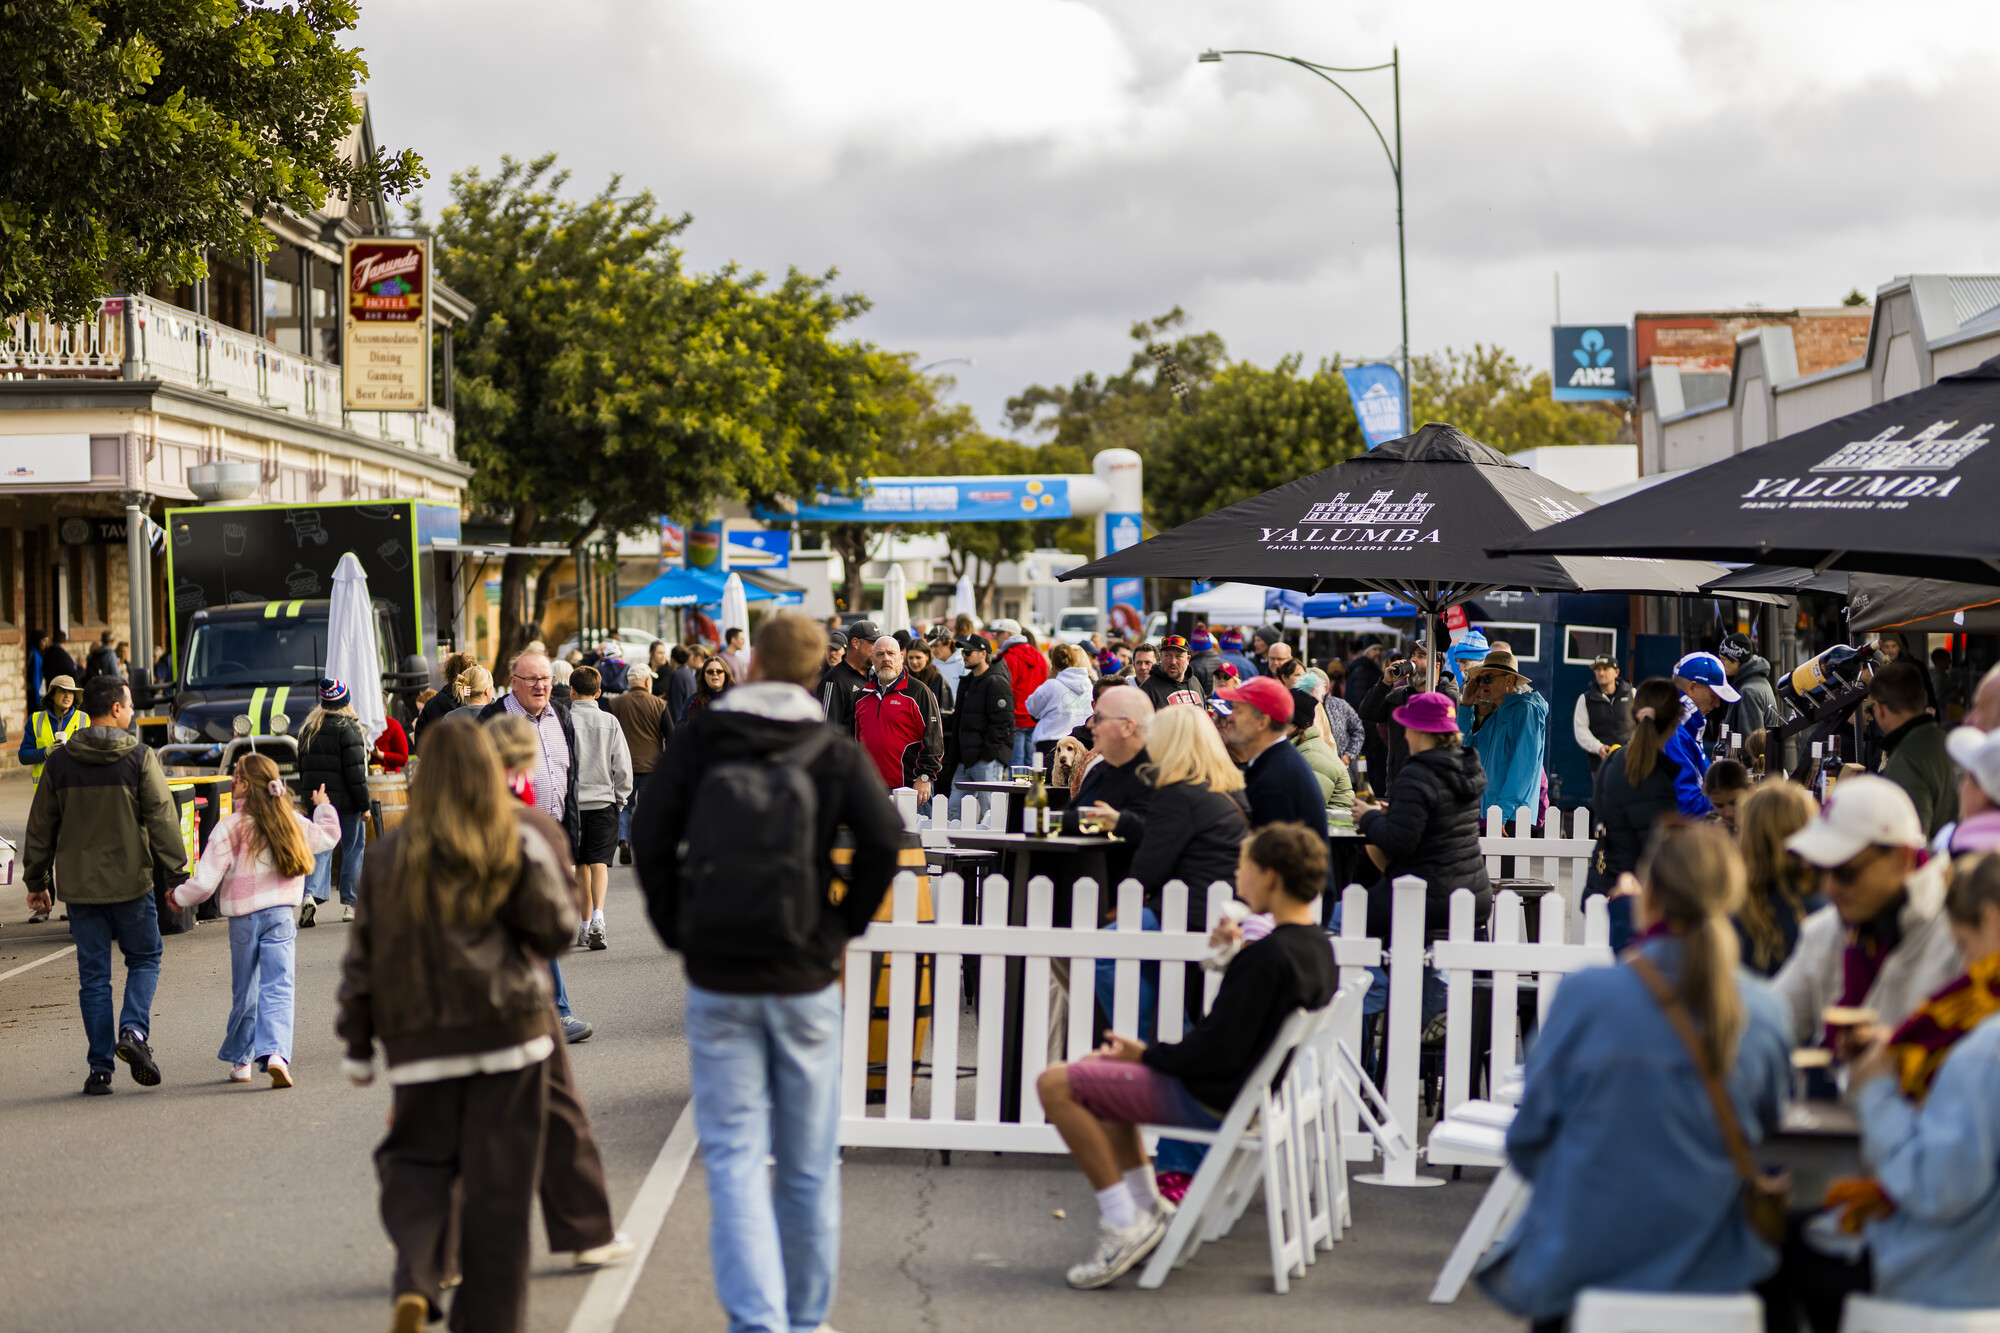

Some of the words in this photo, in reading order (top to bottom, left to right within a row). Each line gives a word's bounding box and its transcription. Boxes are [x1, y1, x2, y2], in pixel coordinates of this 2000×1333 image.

[352, 249, 419, 292] Tanunda
[366, 298, 406, 308] HOTEL
[352, 332, 418, 344] Accommodation
[369, 350, 402, 366] Dining
[367, 369, 403, 384] Gaming
[1569, 367, 1616, 386] ANZ
[356, 387, 376, 399] Beer
[381, 387, 414, 400] Garden
[1741, 476, 1961, 498] YALUMBA
[99, 524, 128, 537] TAV
[1258, 528, 1440, 543] YALUMBA
